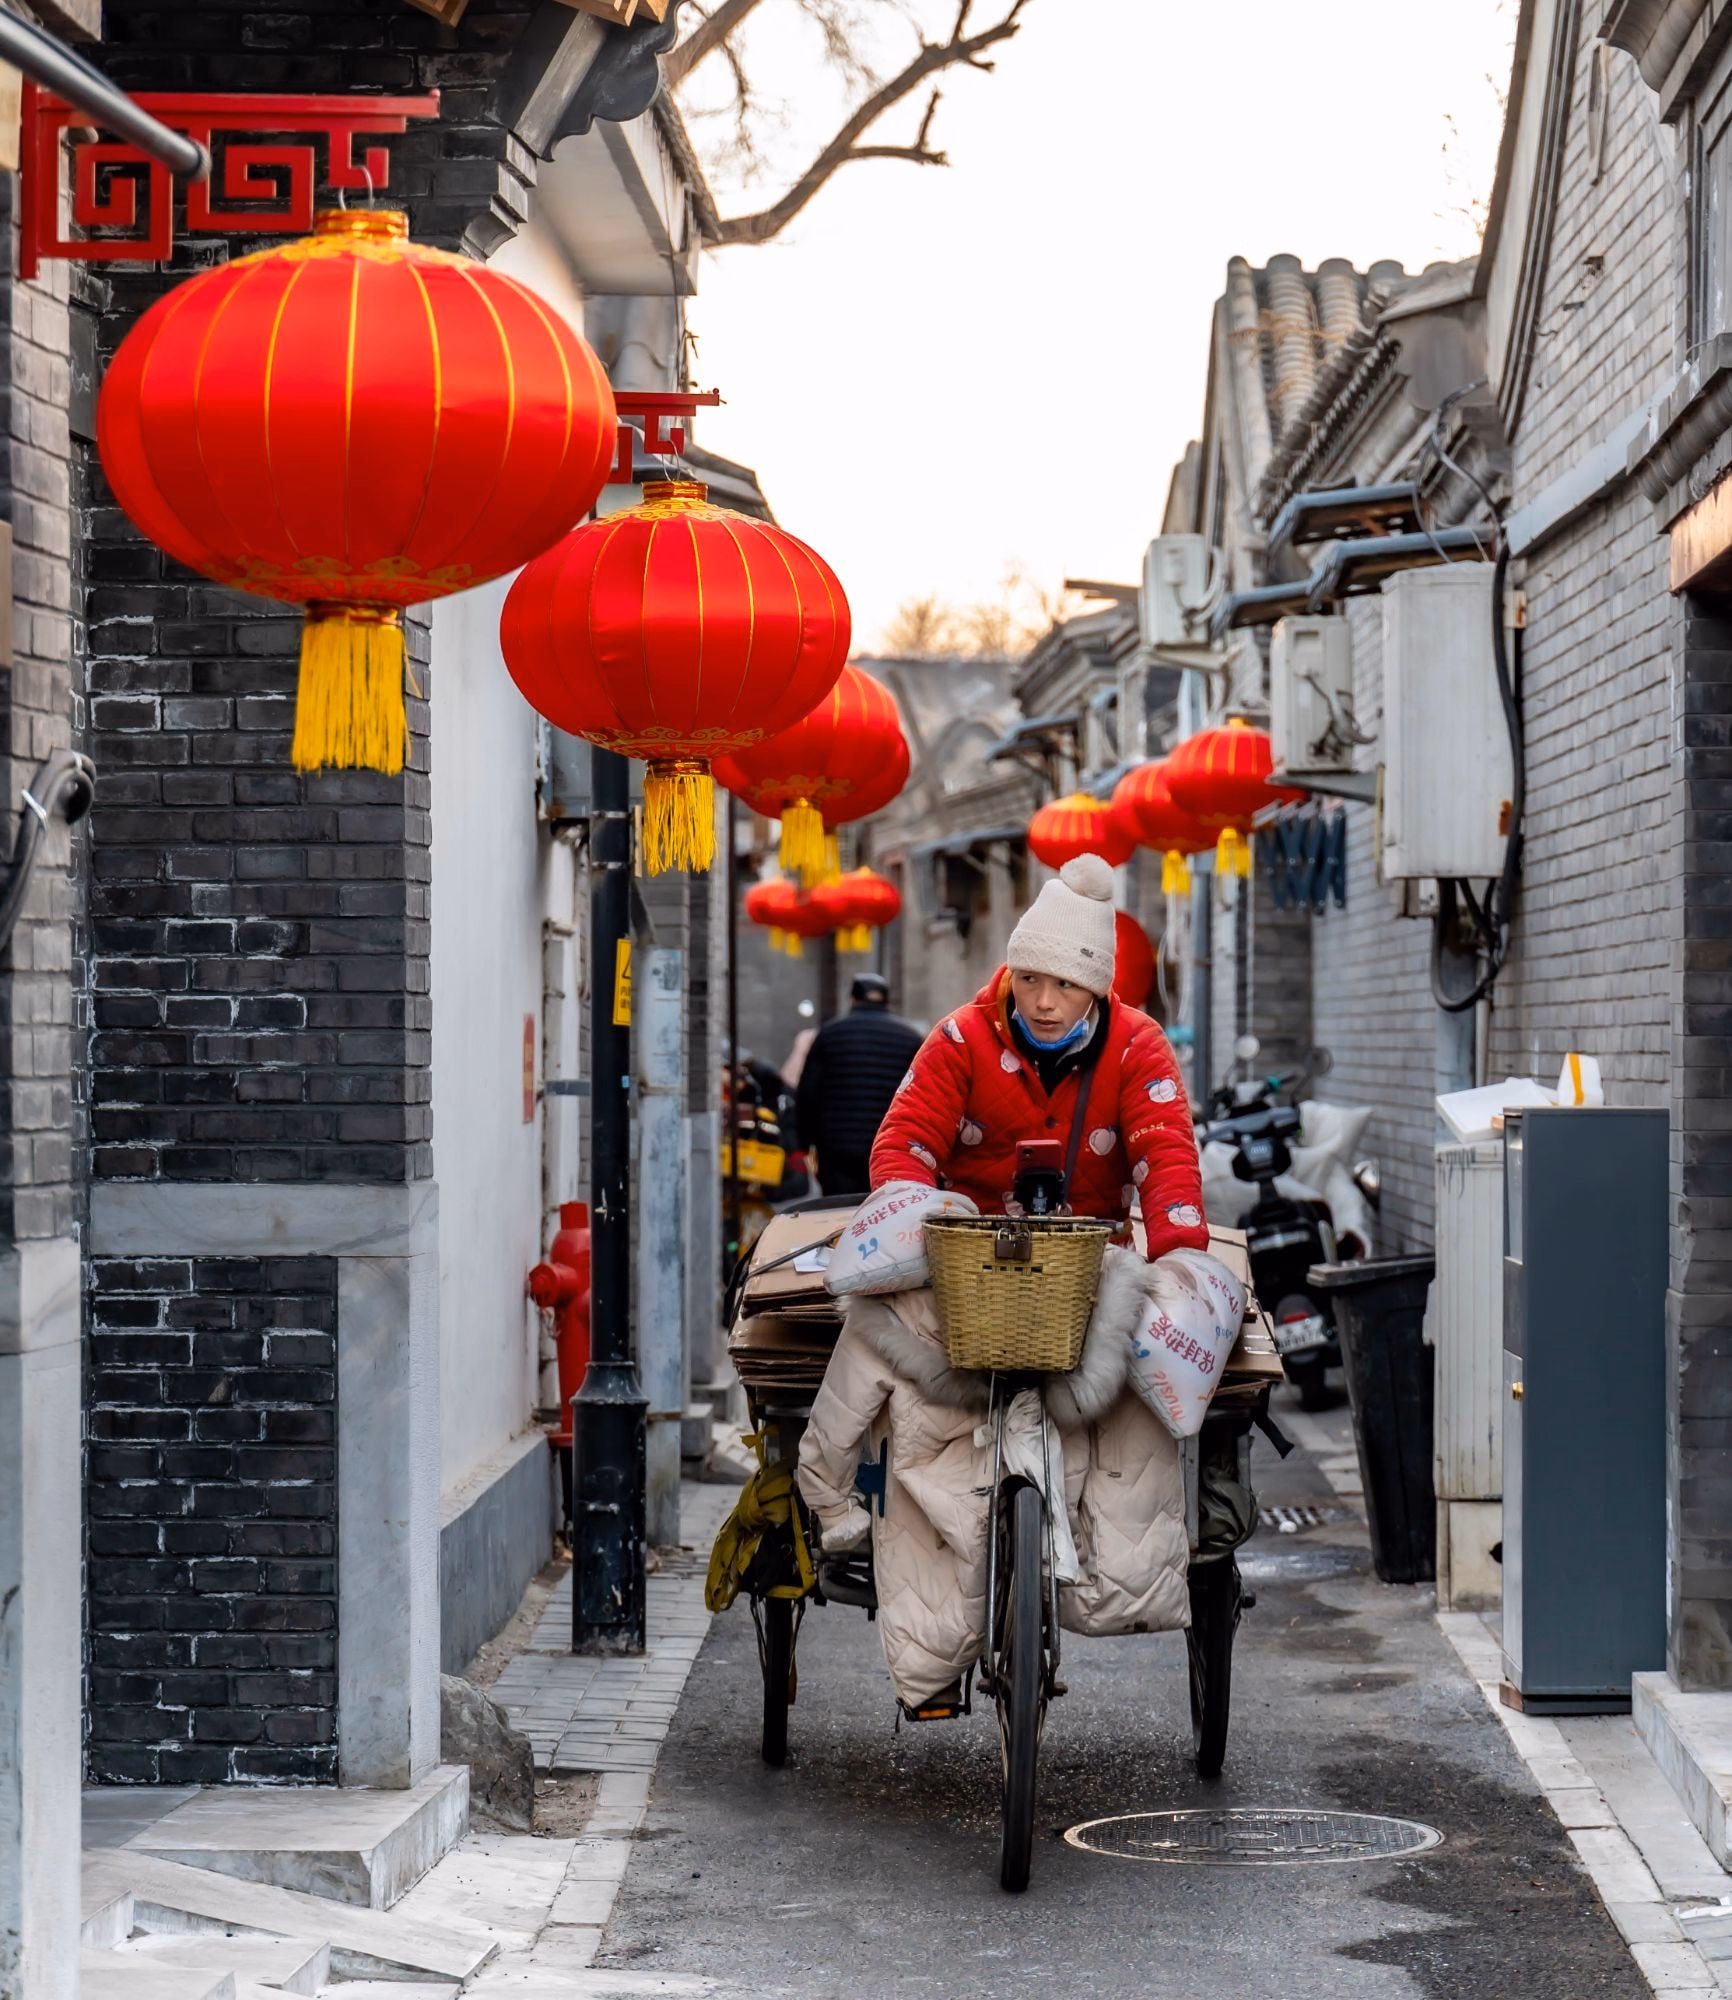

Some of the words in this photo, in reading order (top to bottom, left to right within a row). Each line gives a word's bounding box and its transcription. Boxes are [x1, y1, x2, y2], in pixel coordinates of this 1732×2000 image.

[1129, 1121, 1165, 1143] peach
[851, 1192, 930, 1238] 保持热爱
[1148, 1313, 1216, 1375] 保持热爱
